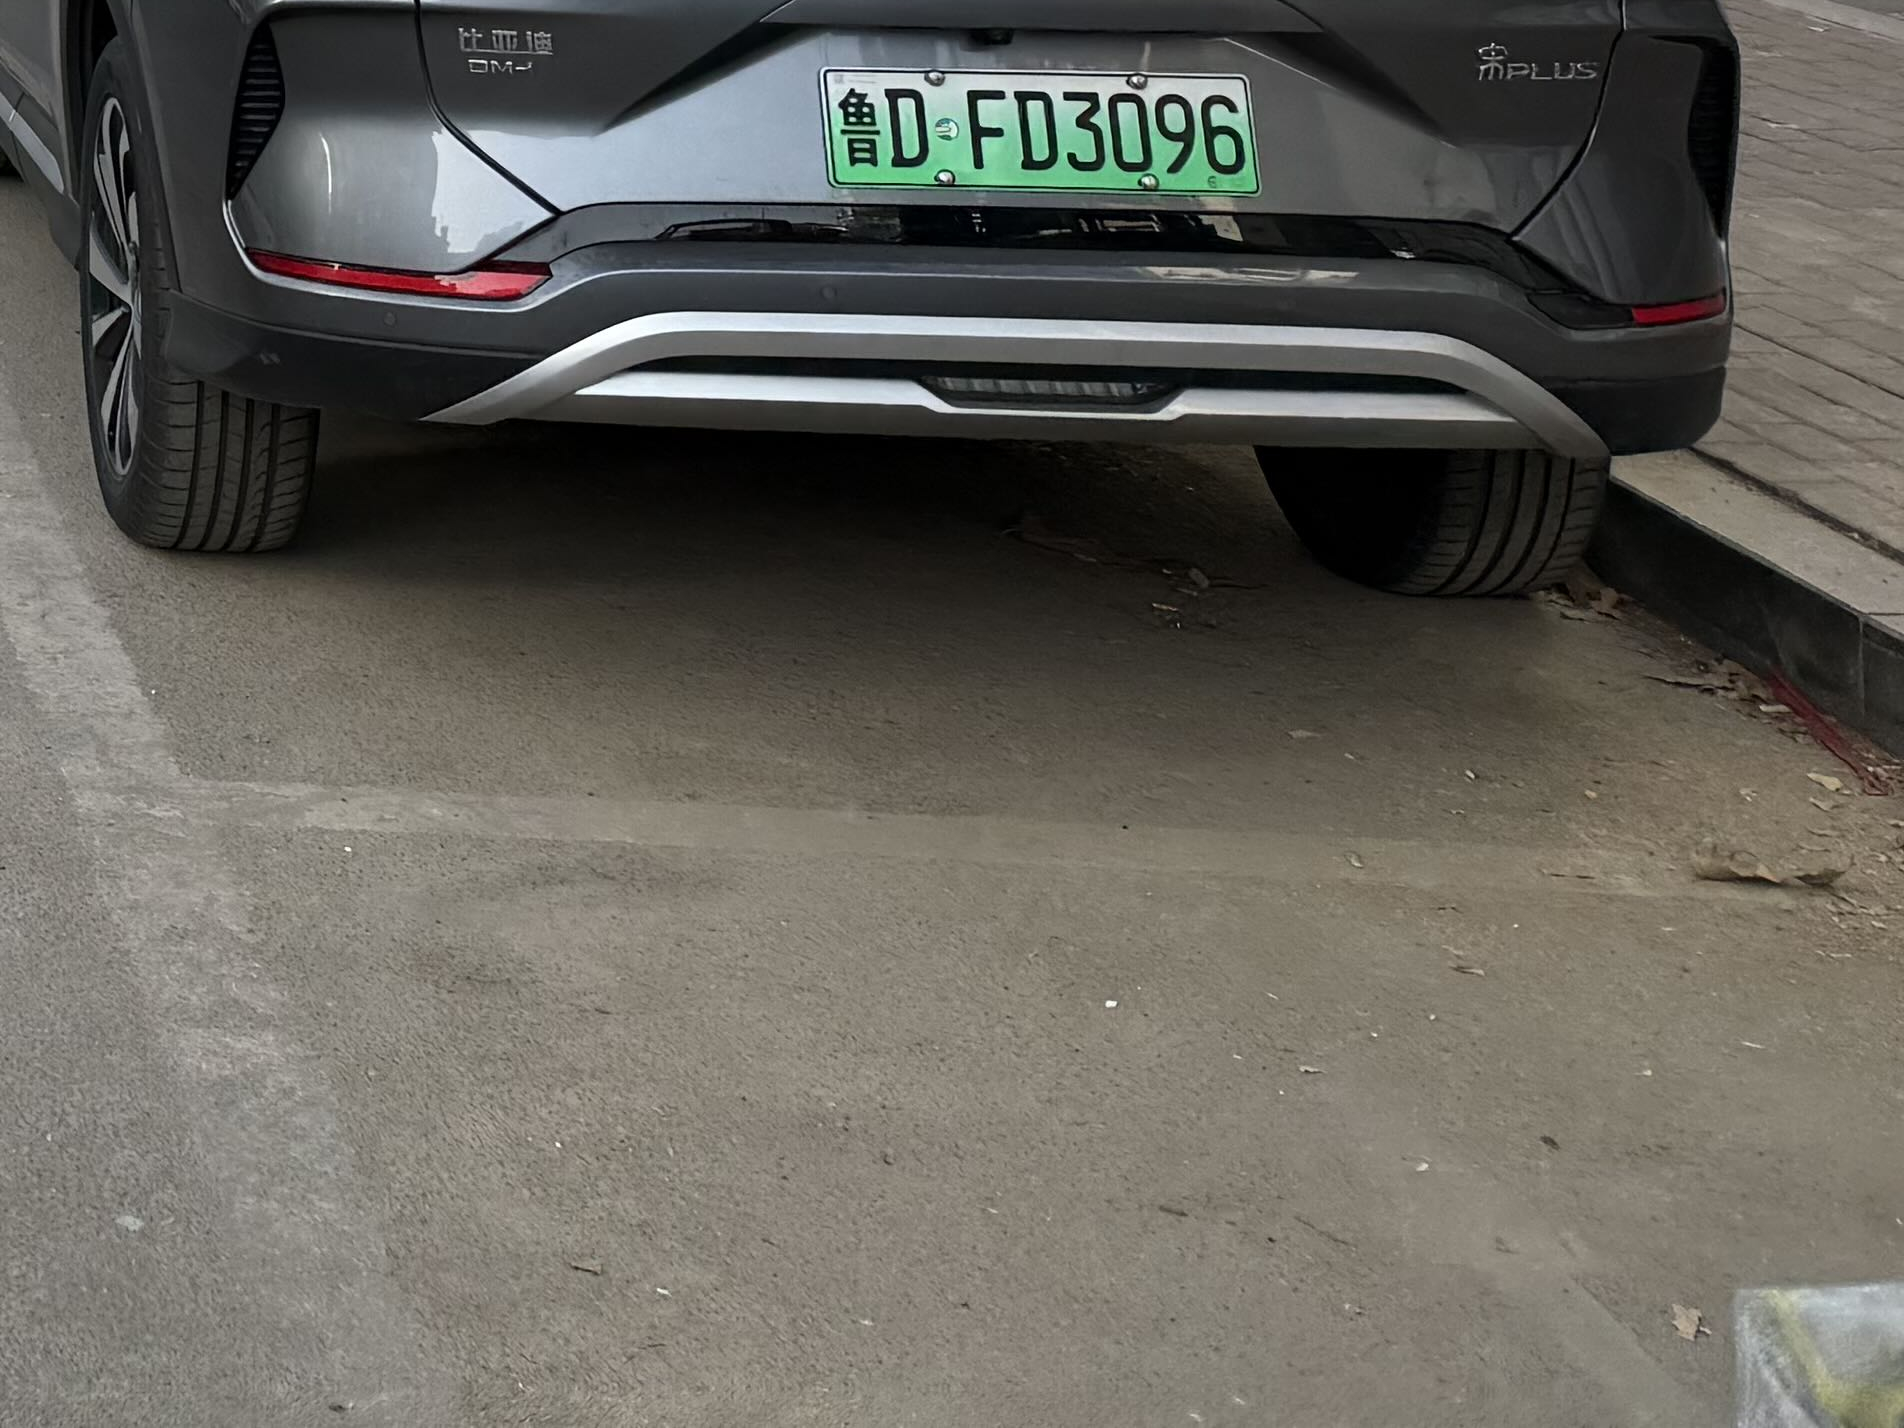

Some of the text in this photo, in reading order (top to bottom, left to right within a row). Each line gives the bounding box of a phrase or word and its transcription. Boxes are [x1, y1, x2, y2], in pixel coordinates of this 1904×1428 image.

[457, 26, 553, 55] 比亚迪
[1506, 61, 1598, 81] PLUS
